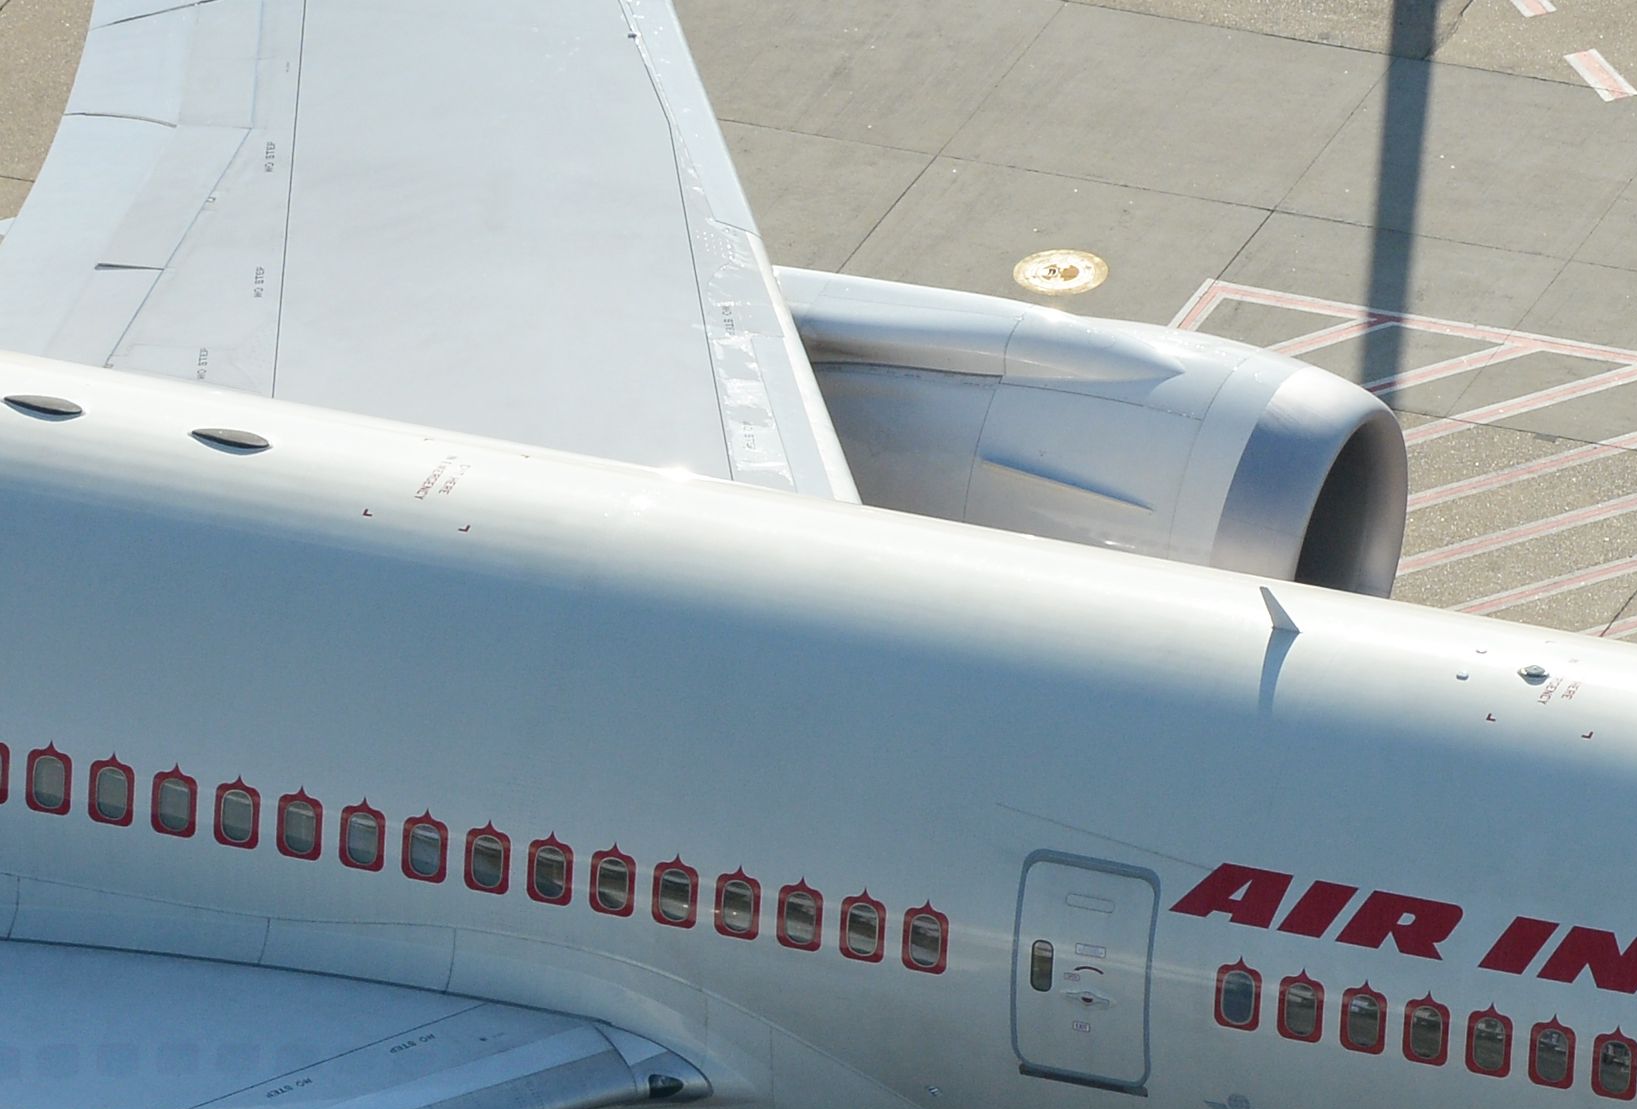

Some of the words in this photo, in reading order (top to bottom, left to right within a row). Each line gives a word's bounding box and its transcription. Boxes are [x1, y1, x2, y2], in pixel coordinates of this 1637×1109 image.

[1174, 864, 1463, 958] AIR
[388, 1040, 417, 1054] STEP
[265, 1084, 293, 1099] STEP
